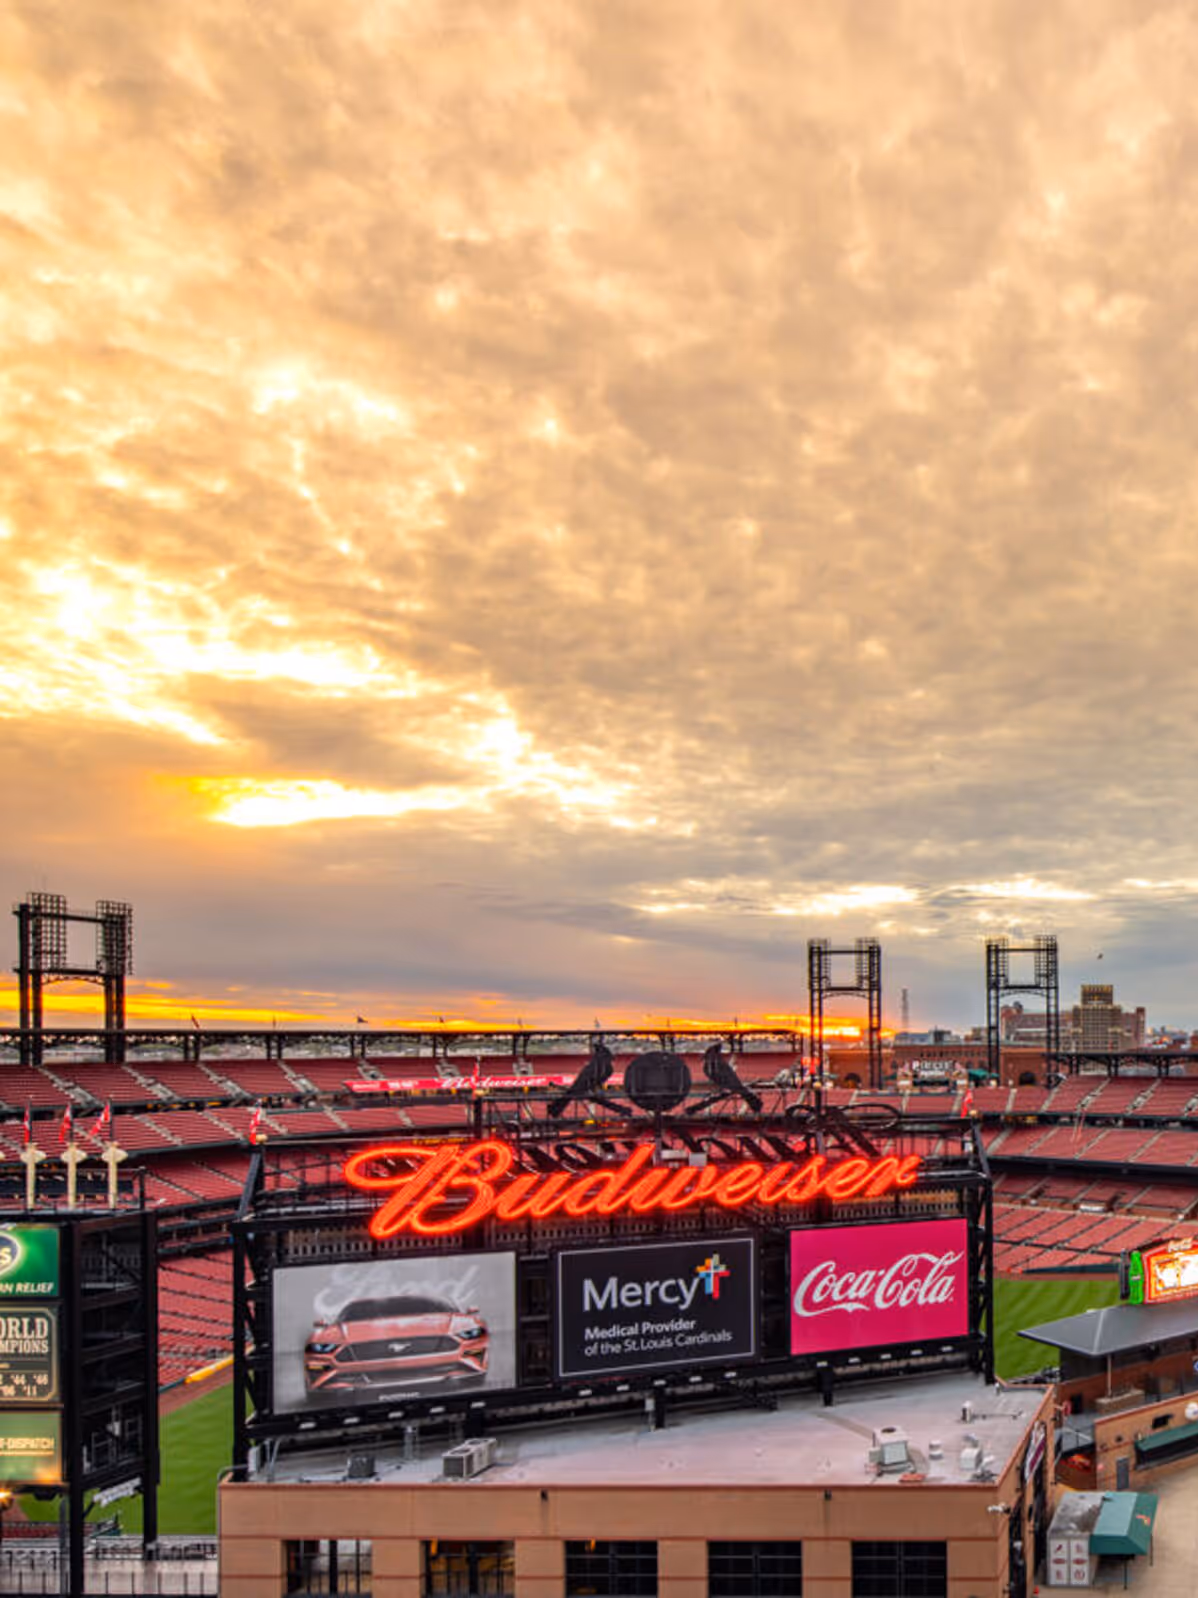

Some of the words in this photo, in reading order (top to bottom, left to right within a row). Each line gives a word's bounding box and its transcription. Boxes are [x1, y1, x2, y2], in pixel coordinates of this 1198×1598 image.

[434, 1074, 546, 1090] Budweiser
[341, 1139, 923, 1240] Budweiser
[582, 1275, 701, 1313] Mercy
[793, 1250, 965, 1317] Coca-Cola
[584, 1323, 639, 1341] Medical
[641, 1318, 696, 1335] Provider
[584, 1343, 600, 1357] of
[601, 1341, 622, 1354] the
[640, 1337, 673, 1351] Louis
[675, 1329, 733, 1347] Cardinals
